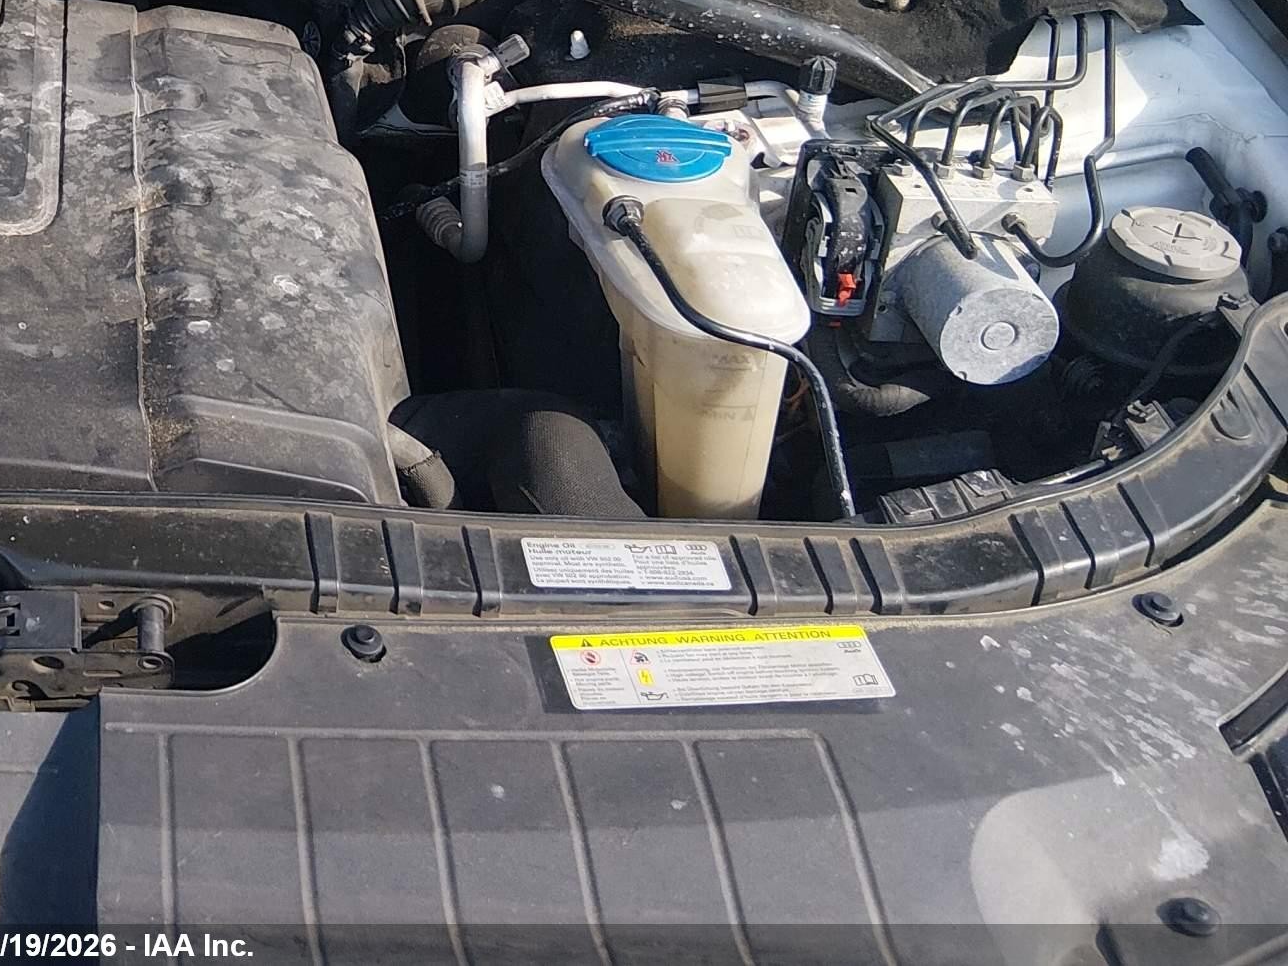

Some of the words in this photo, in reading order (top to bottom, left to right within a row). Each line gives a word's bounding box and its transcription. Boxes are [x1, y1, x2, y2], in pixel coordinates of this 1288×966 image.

[526, 541, 560, 550] Engine
[562, 541, 576, 549] Oil
[599, 636, 668, 646] ACHTUNG
[675, 633, 744, 644] WARNING
[754, 630, 831, 641] ATTENTION
